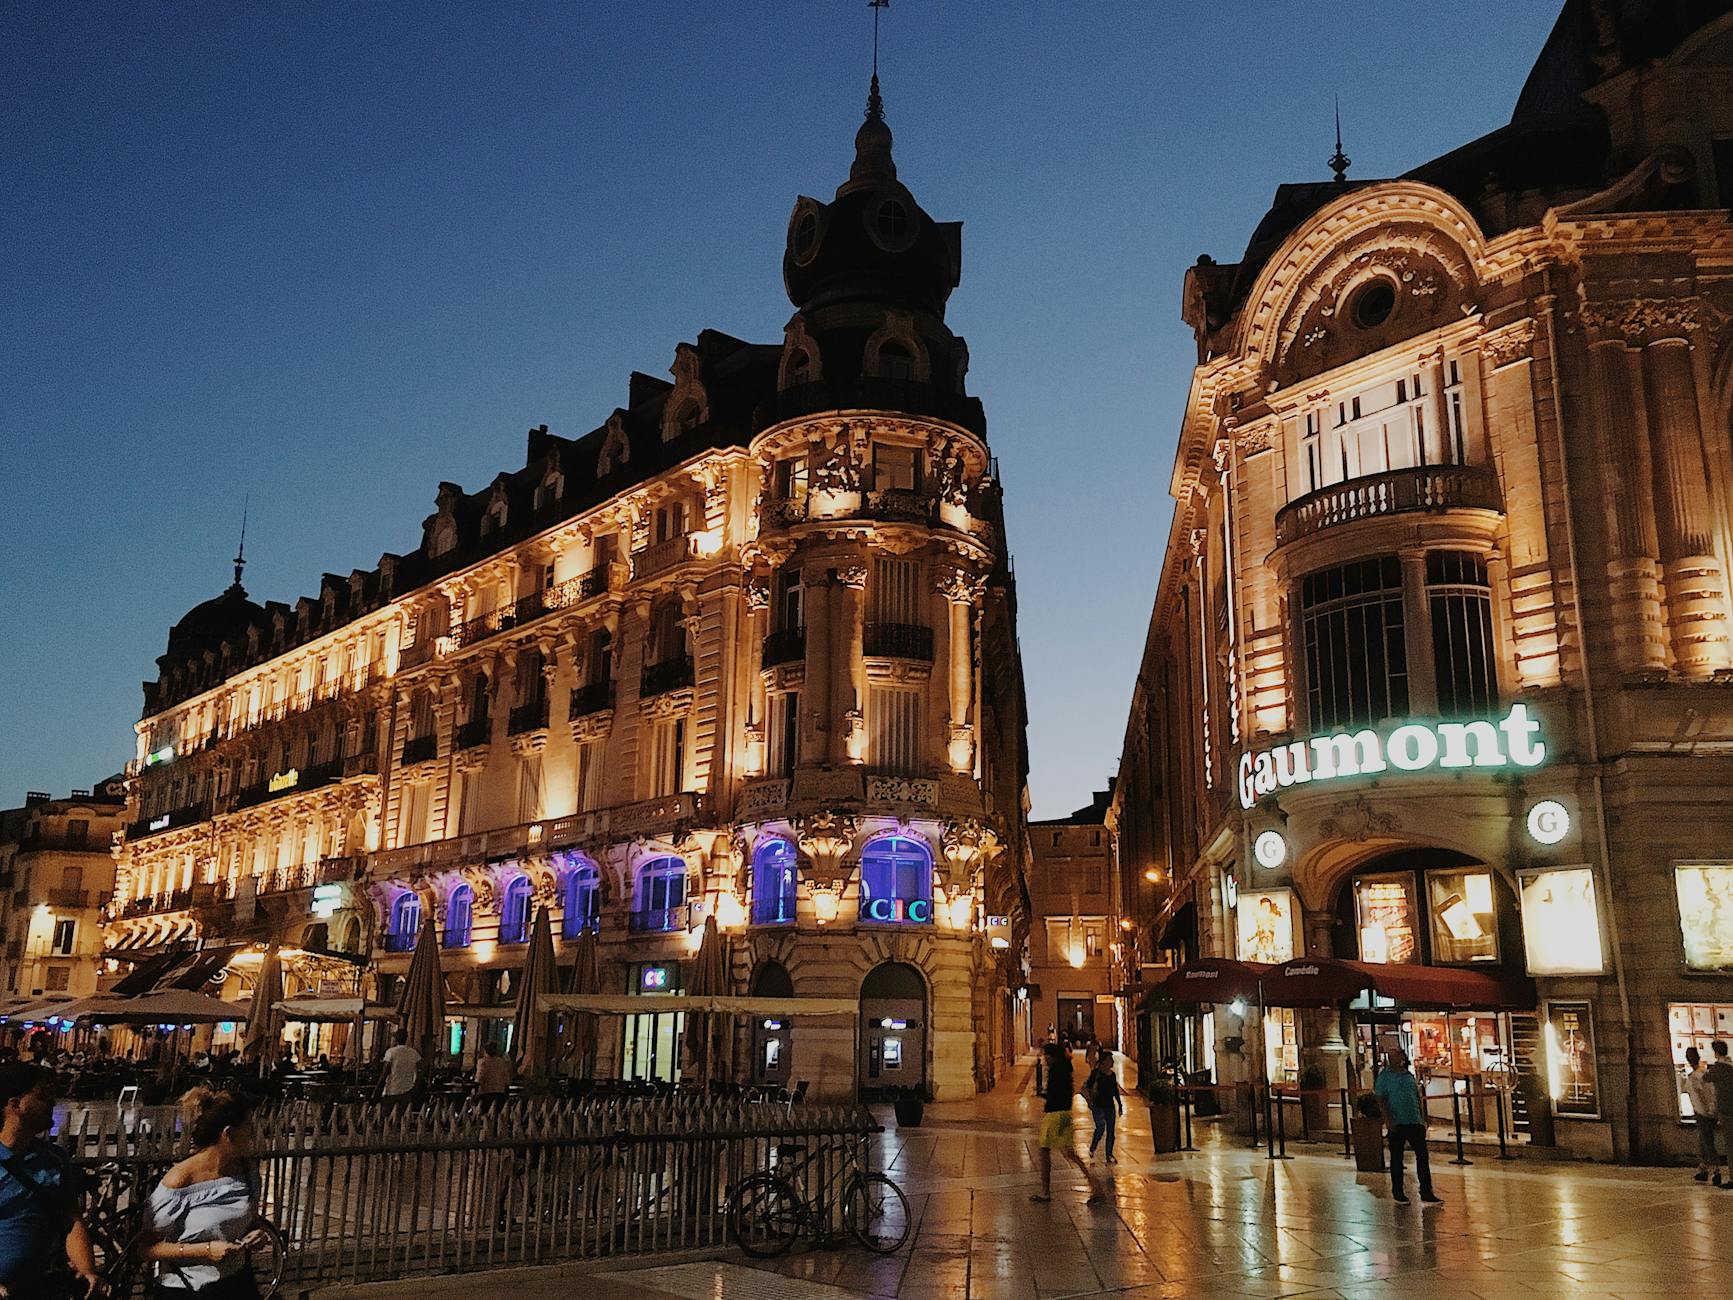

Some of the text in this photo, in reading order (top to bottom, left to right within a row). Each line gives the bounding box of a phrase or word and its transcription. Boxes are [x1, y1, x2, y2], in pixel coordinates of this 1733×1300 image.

[1238, 702, 1547, 810] Gaumont
[869, 898, 927, 923] CIC
[1284, 964, 1320, 977] Comédie
